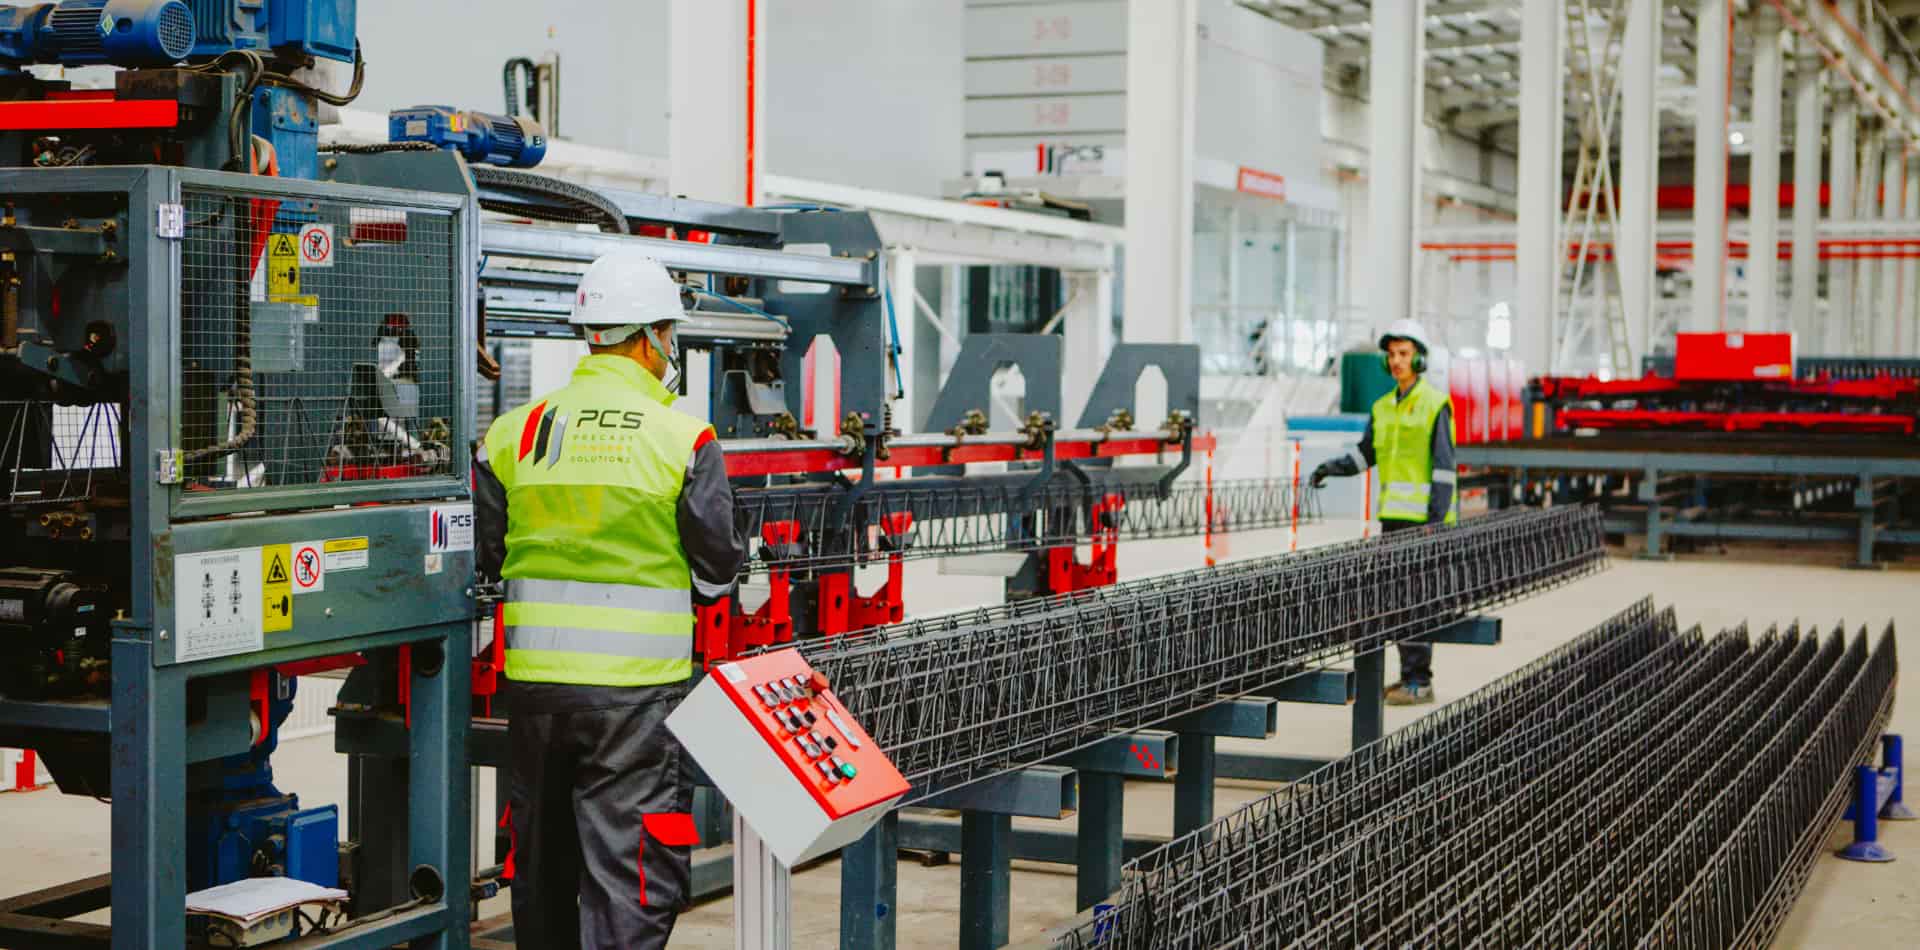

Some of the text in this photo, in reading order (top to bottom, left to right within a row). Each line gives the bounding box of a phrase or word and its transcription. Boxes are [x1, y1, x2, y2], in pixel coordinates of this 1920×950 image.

[1061, 145, 1104, 160] PCS
[576, 410, 644, 430] PCS
[450, 515, 472, 527] PCS
